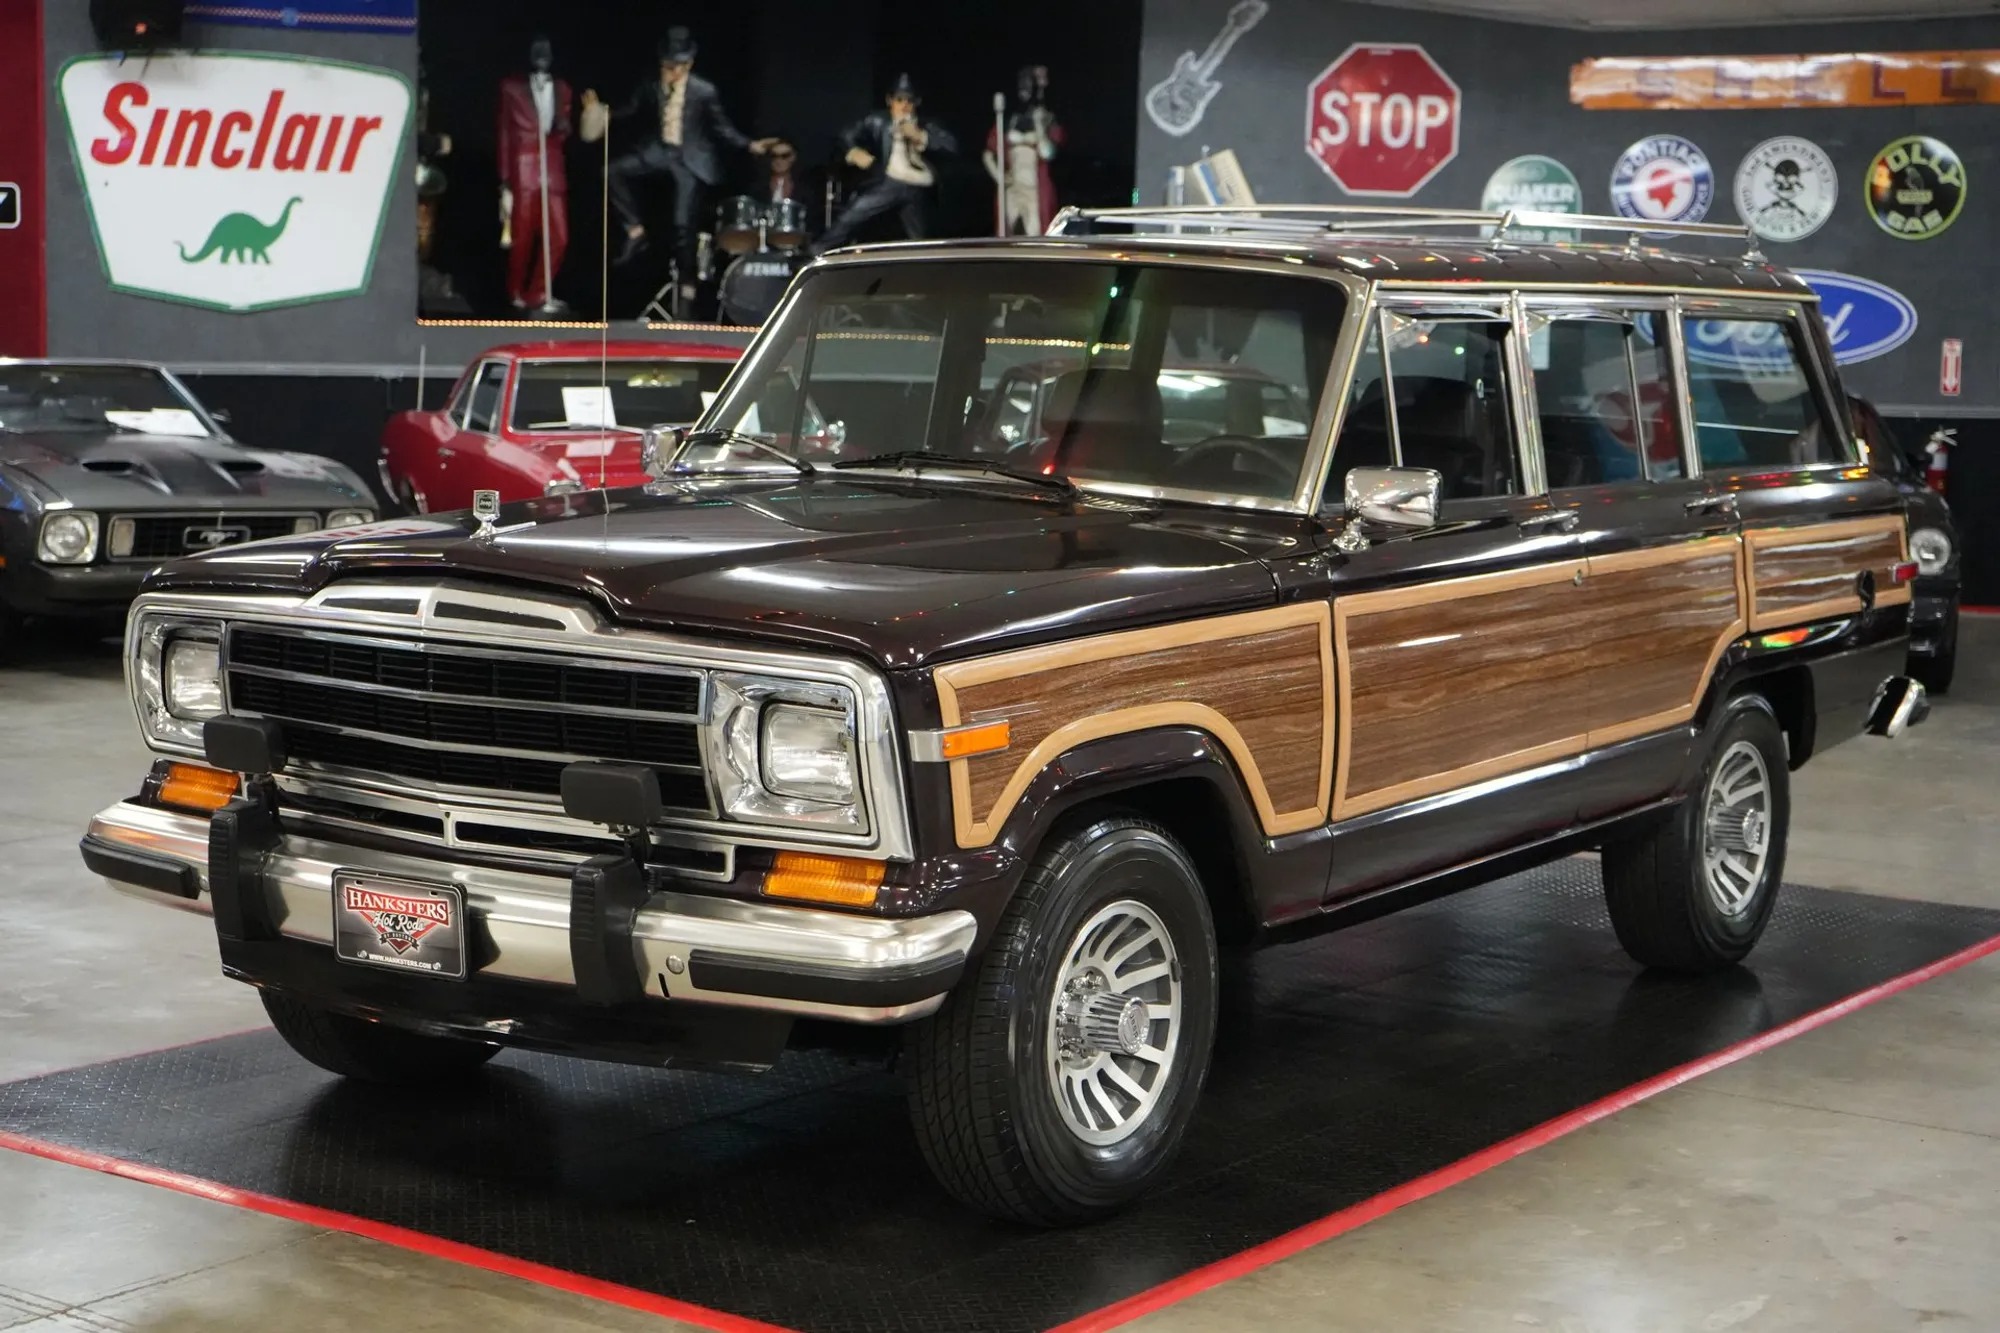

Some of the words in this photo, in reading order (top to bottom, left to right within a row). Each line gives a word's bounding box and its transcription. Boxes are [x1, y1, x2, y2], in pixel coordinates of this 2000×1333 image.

[90, 81, 382, 174] Sinclair
[1318, 89, 1450, 149] STOP
[1621, 141, 1703, 175] PONTIAC
[1491, 182, 1576, 204] QUAKER
[1887, 209, 1944, 233] GAS
[349, 890, 446, 921] HANKSTERS
[372, 911, 395, 927] Hot
[396, 914, 425, 934] Rods
[368, 953, 432, 969] WWW.HANKSTERS.COM
